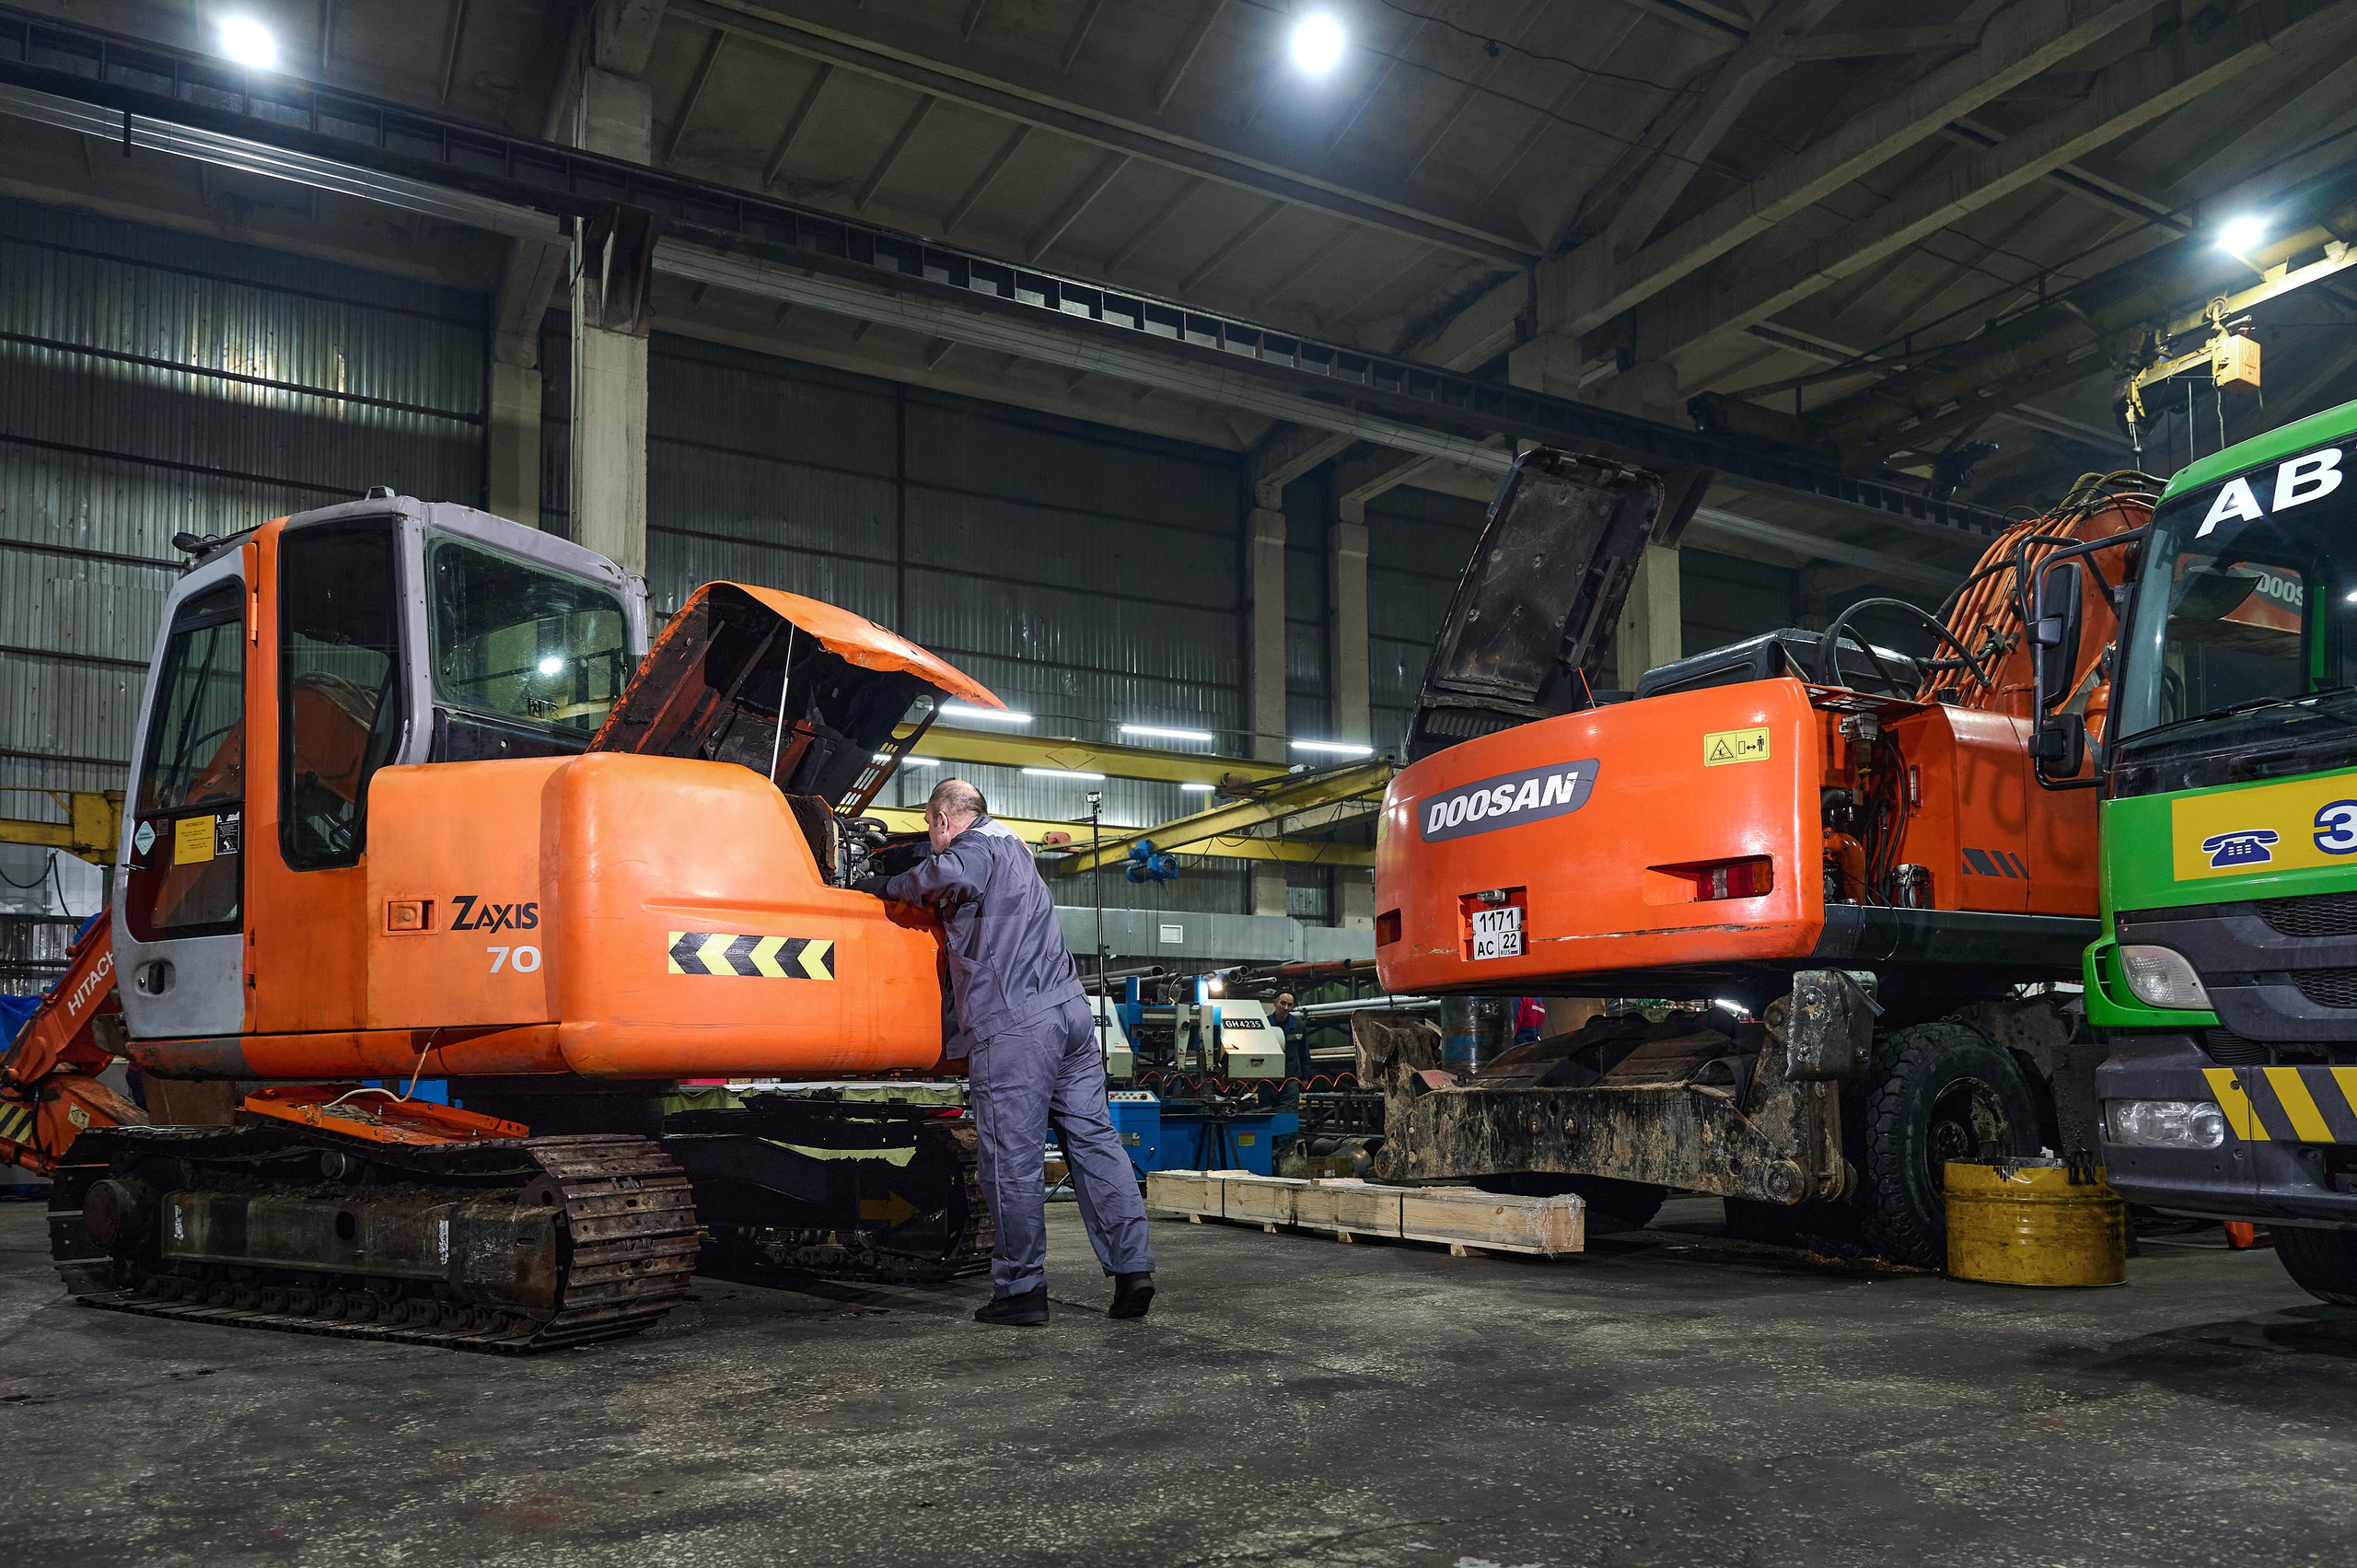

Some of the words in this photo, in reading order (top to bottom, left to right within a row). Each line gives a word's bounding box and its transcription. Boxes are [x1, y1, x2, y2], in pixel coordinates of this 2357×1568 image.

[2194, 442, 2357, 540] AB
[1426, 771, 1579, 834] DOOSAN
[450, 895, 539, 934] ZAXIS
[1480, 910, 1514, 932] 1171
[1478, 940, 1494, 957] AC
[1503, 933, 1516, 948] 22
[486, 946, 541, 973] 70
